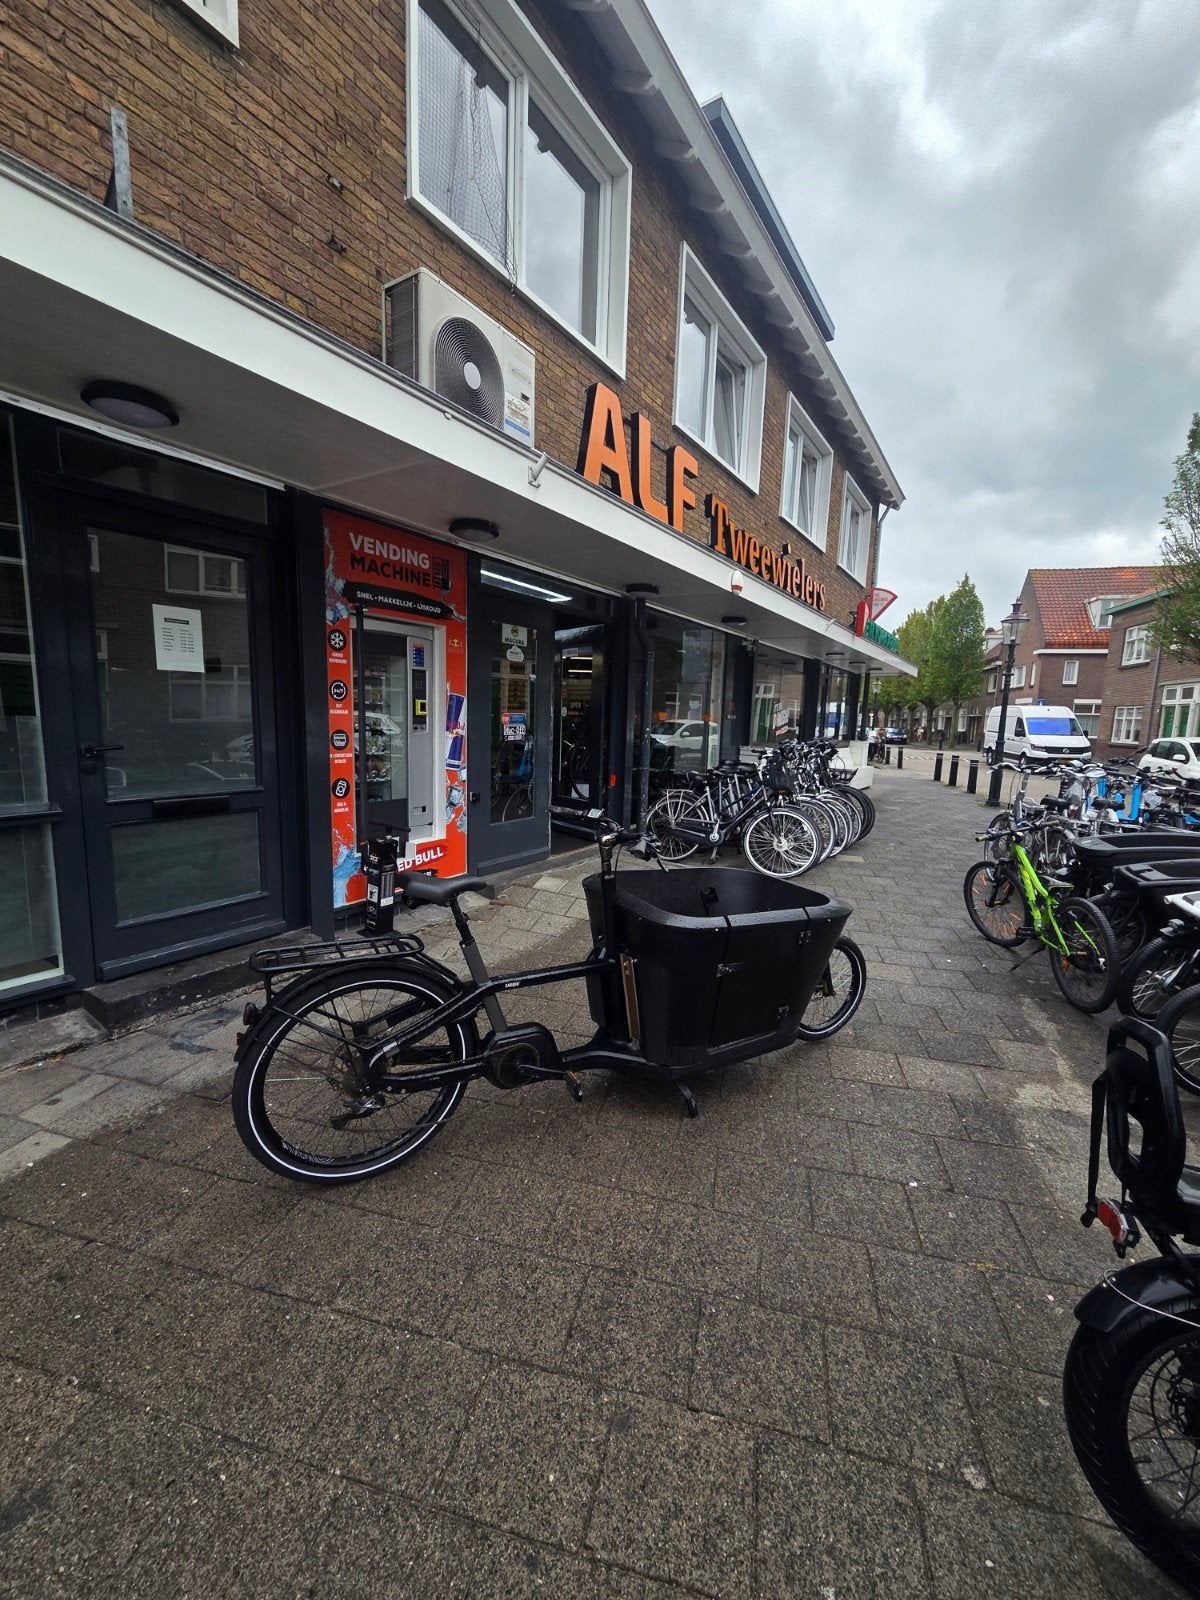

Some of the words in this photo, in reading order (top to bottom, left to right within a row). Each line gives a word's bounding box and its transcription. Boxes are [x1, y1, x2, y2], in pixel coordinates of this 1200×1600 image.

[580, 382, 699, 533] ALF
[706, 494, 826, 611] Tweewielers
[349, 532, 430, 569] VENDING
[350, 553, 431, 588] MACHINE
[356, 590, 374, 601] SNEL
[378, 595, 413, 608] MAKKELIJK
[416, 604, 441, 614] IJSKOUD
[396, 858, 413, 873] ED
[415, 846, 444, 866] BULL
